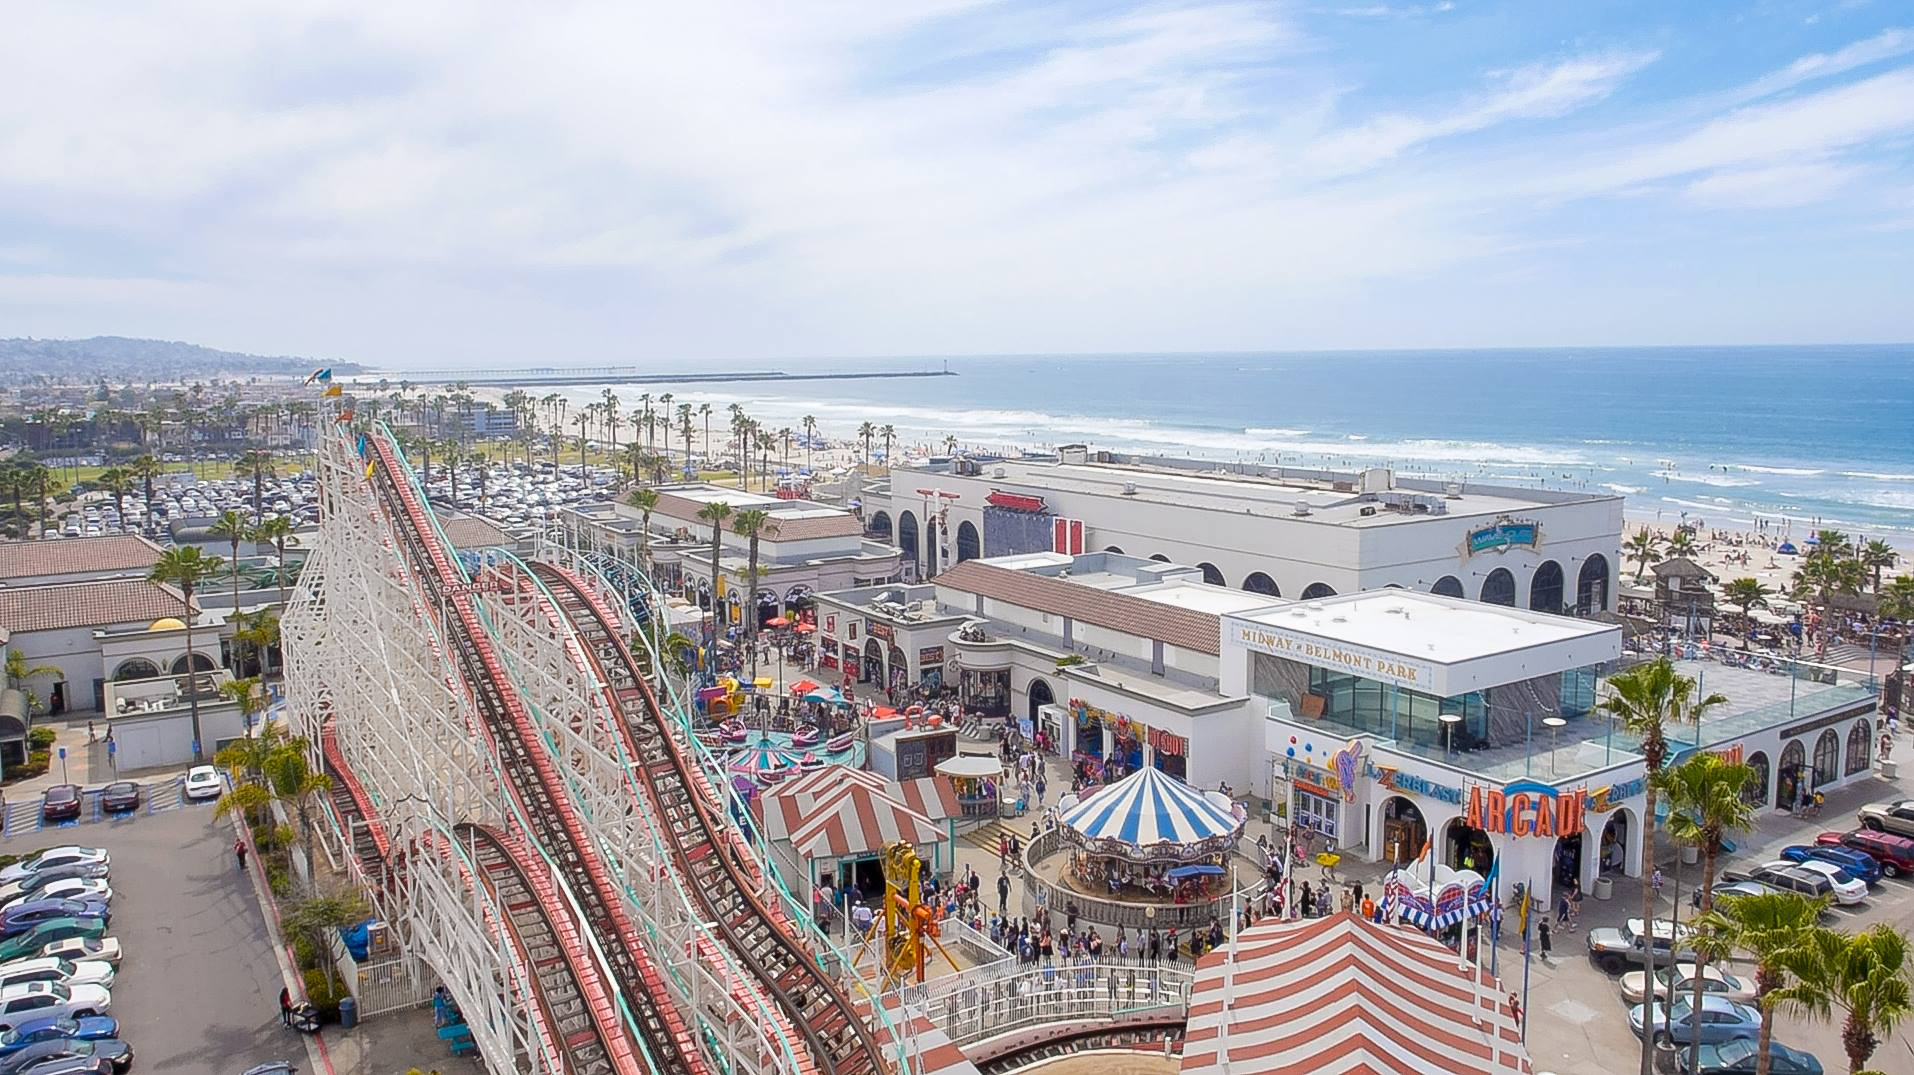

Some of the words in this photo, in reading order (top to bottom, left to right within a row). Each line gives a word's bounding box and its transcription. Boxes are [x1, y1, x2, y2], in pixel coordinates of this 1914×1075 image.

[442, 581, 498, 593] DANGER
[1241, 628, 1292, 650] MIDWAY
[1305, 643, 1372, 669] BELMONT
[1377, 660, 1417, 681] PARK
[1466, 784, 1588, 838] ARCADE
